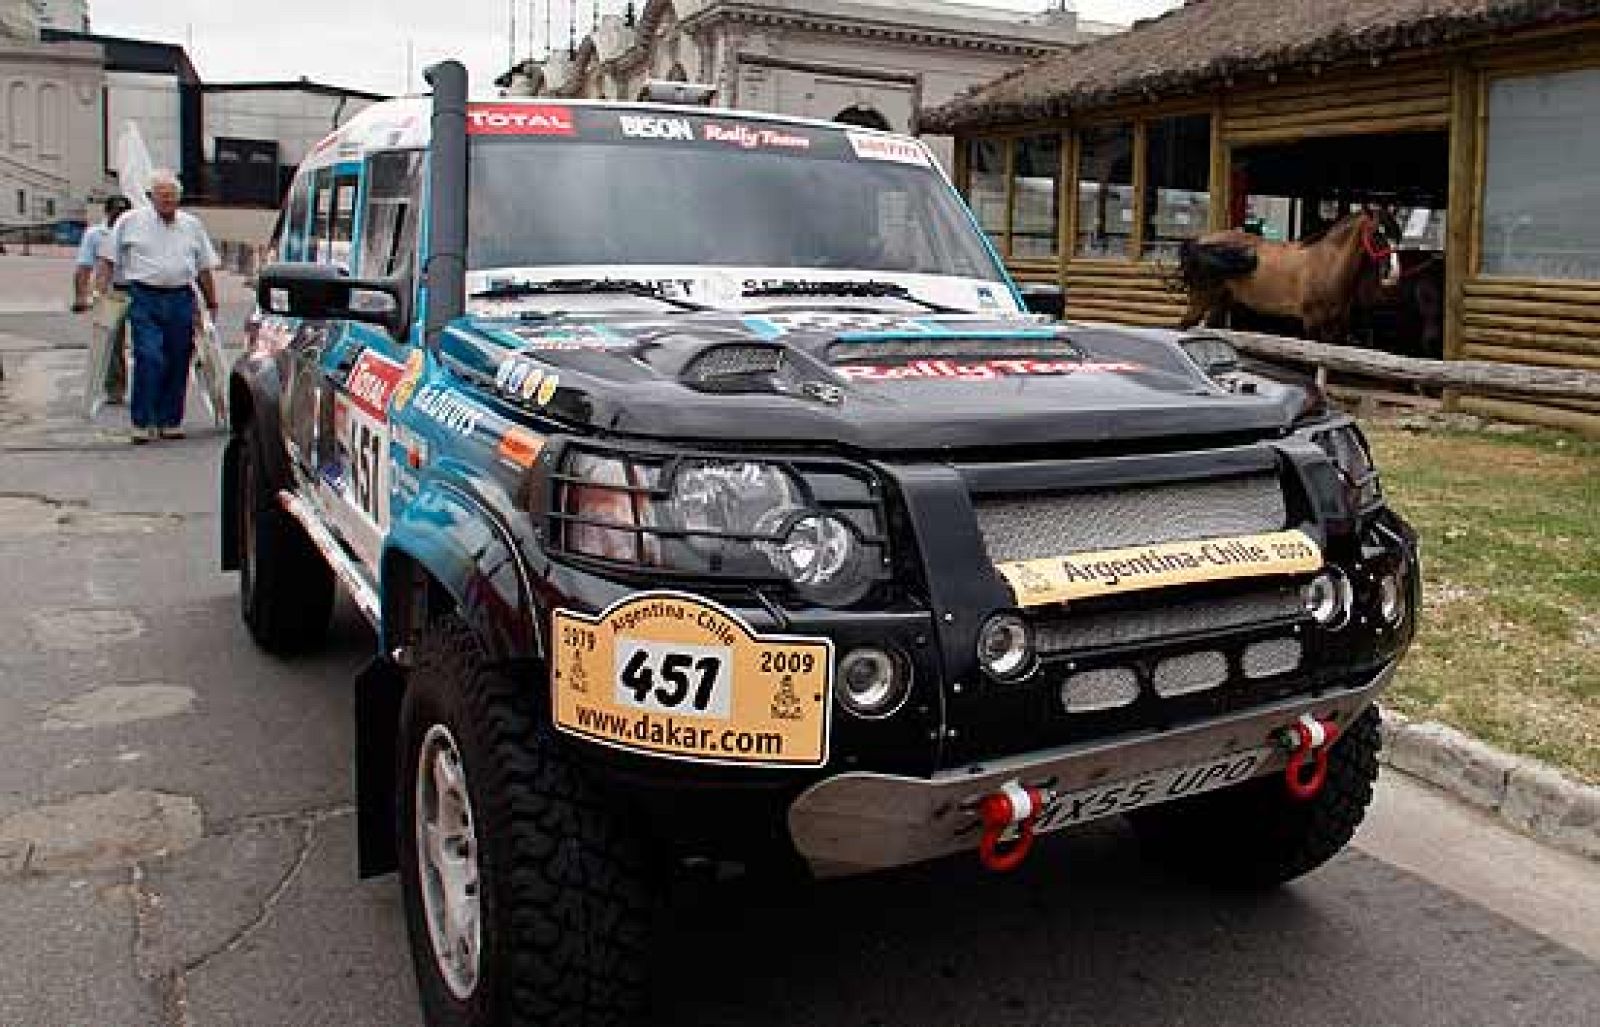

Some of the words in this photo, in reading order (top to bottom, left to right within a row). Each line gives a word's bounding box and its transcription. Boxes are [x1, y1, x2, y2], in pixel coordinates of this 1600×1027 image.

[467, 111, 571, 129] TOTAL
[619, 115, 694, 140] BISON
[703, 124, 759, 148] Rally
[761, 130, 810, 149] Team
[610, 601, 686, 635] Argentina
[697, 610, 738, 647] Chile
[761, 651, 815, 673] 2009
[620, 648, 722, 711] 451
[575, 703, 783, 754] www.dakar.com
